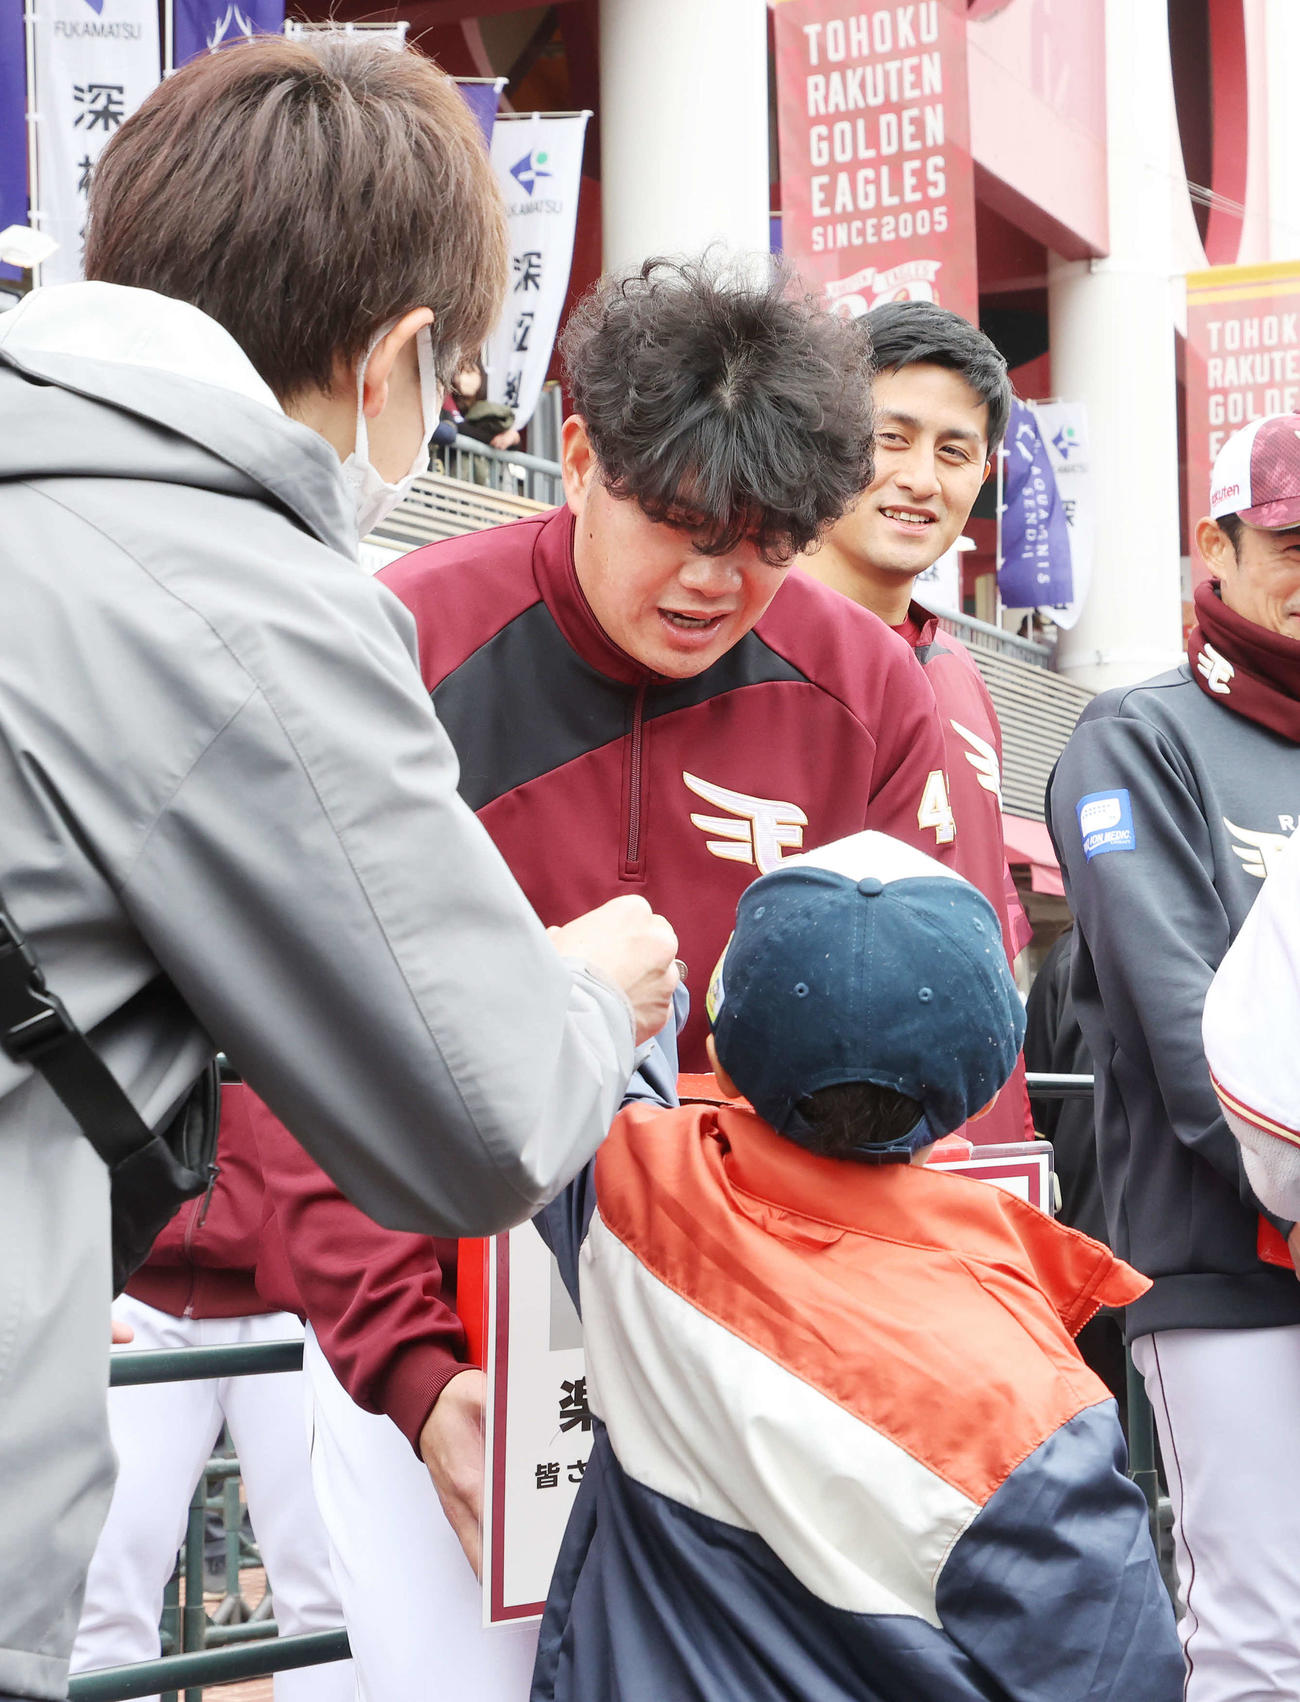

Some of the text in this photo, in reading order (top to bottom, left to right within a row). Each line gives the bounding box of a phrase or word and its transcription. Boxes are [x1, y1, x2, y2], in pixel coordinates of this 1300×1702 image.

[54, 20, 142, 39] FUKAMATSU
[803, 1, 938, 66] TOHOKU
[806, 51, 943, 117] RAKUTEN
[810, 103, 945, 167] GOLDEN
[811, 155, 946, 218] EAGLES
[917, 769, 957, 844] 4
